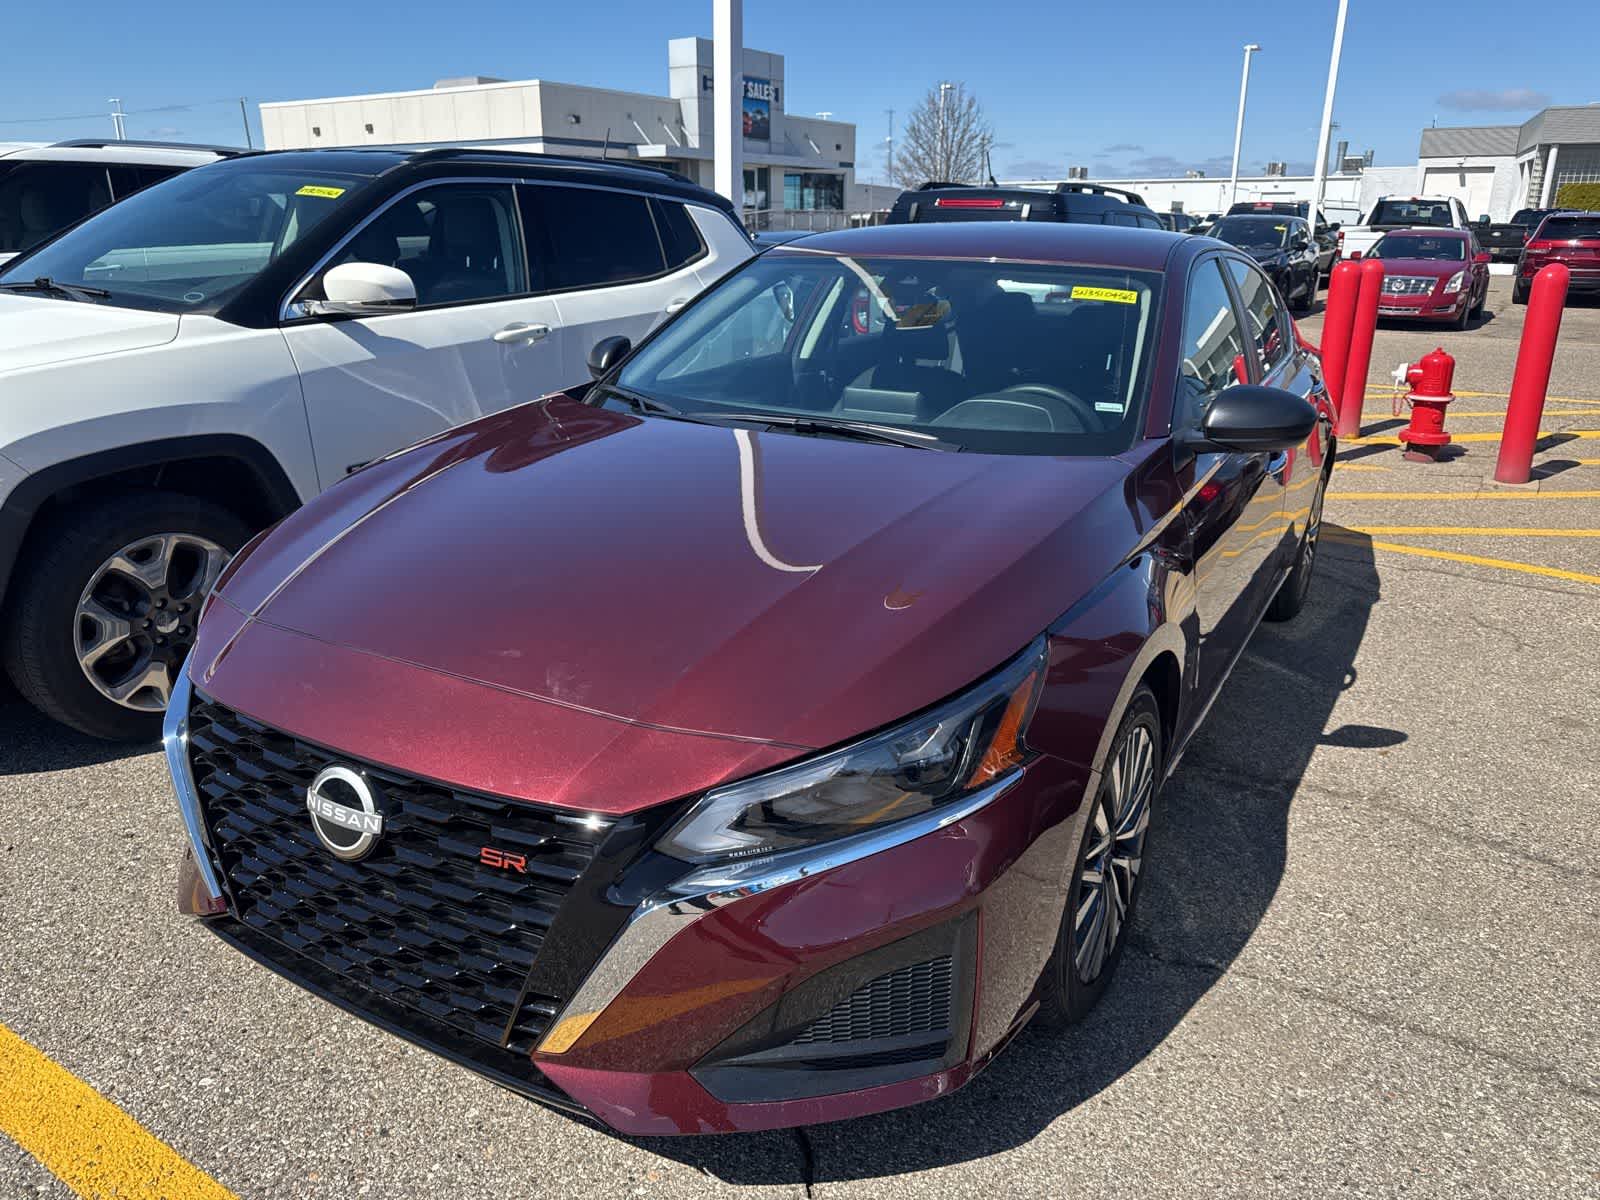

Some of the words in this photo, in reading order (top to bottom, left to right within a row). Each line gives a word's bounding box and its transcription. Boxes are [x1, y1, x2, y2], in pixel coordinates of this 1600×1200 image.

[747, 81, 774, 101] SALES
[307, 795, 380, 832] NISSAN
[480, 847, 527, 873] SR
